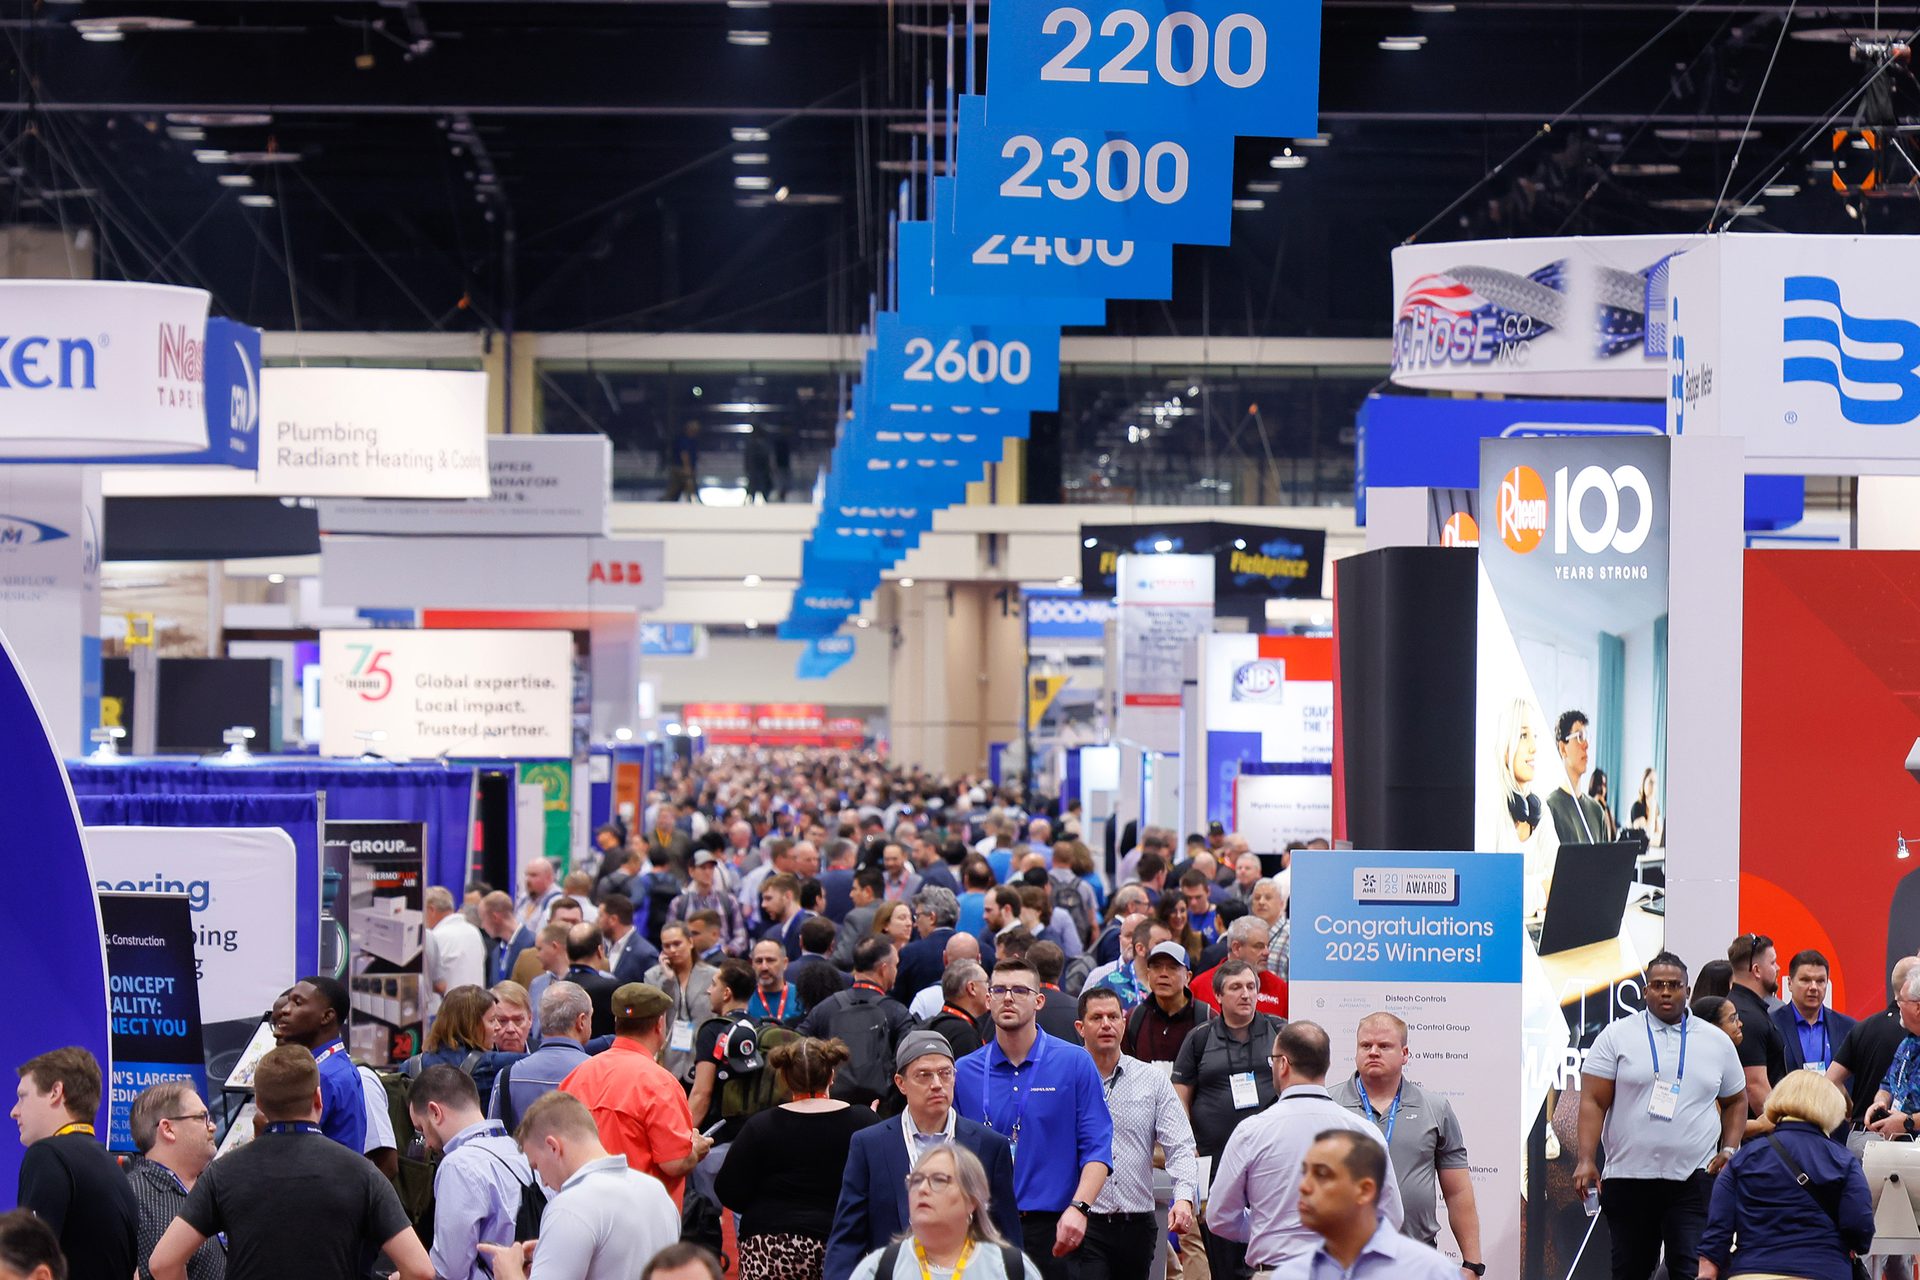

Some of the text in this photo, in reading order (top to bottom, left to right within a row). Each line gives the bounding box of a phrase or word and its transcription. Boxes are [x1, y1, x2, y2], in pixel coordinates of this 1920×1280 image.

[1040, 7, 1267, 88] 2200
[1000, 135, 1189, 204] 2300
[903, 338, 1031, 384] 2600
[277, 422, 378, 445] Plumbing
[277, 447, 359, 468] Radiant
[365, 450, 434, 472] Heating
[438, 452, 449, 470] &
[1501, 466, 1546, 542] Rheem
[1554, 465, 1653, 554] 100
[588, 561, 643, 585] ABB
[1555, 566, 1648, 580] YEARS STRONG
[415, 674, 555, 692] Global expertise.
[415, 698, 525, 716] Local impact.
[416, 722, 549, 740] Trusted partner.
[1384, 873, 1399, 884] 20
[1384, 884, 1399, 894] 25
[1405, 881, 1447, 895] AWARDS
[1314, 915, 1494, 940] Congratulations
[112, 934, 166, 947] Construction
[1325, 942, 1481, 963] 2025 Winners!
[110, 975, 175, 995] ONCEPT
[1385, 995, 1447, 1003] Distech Controls
[152, 1019, 187, 1037] YOU
[1416, 1023, 1445, 1031] Control
[1447, 1023, 1471, 1034] Group
[1422, 1052, 1445, 1060] Watts
[1445, 1052, 1469, 1060] Brand
[1444, 1249, 1460, 1259] Inc.
